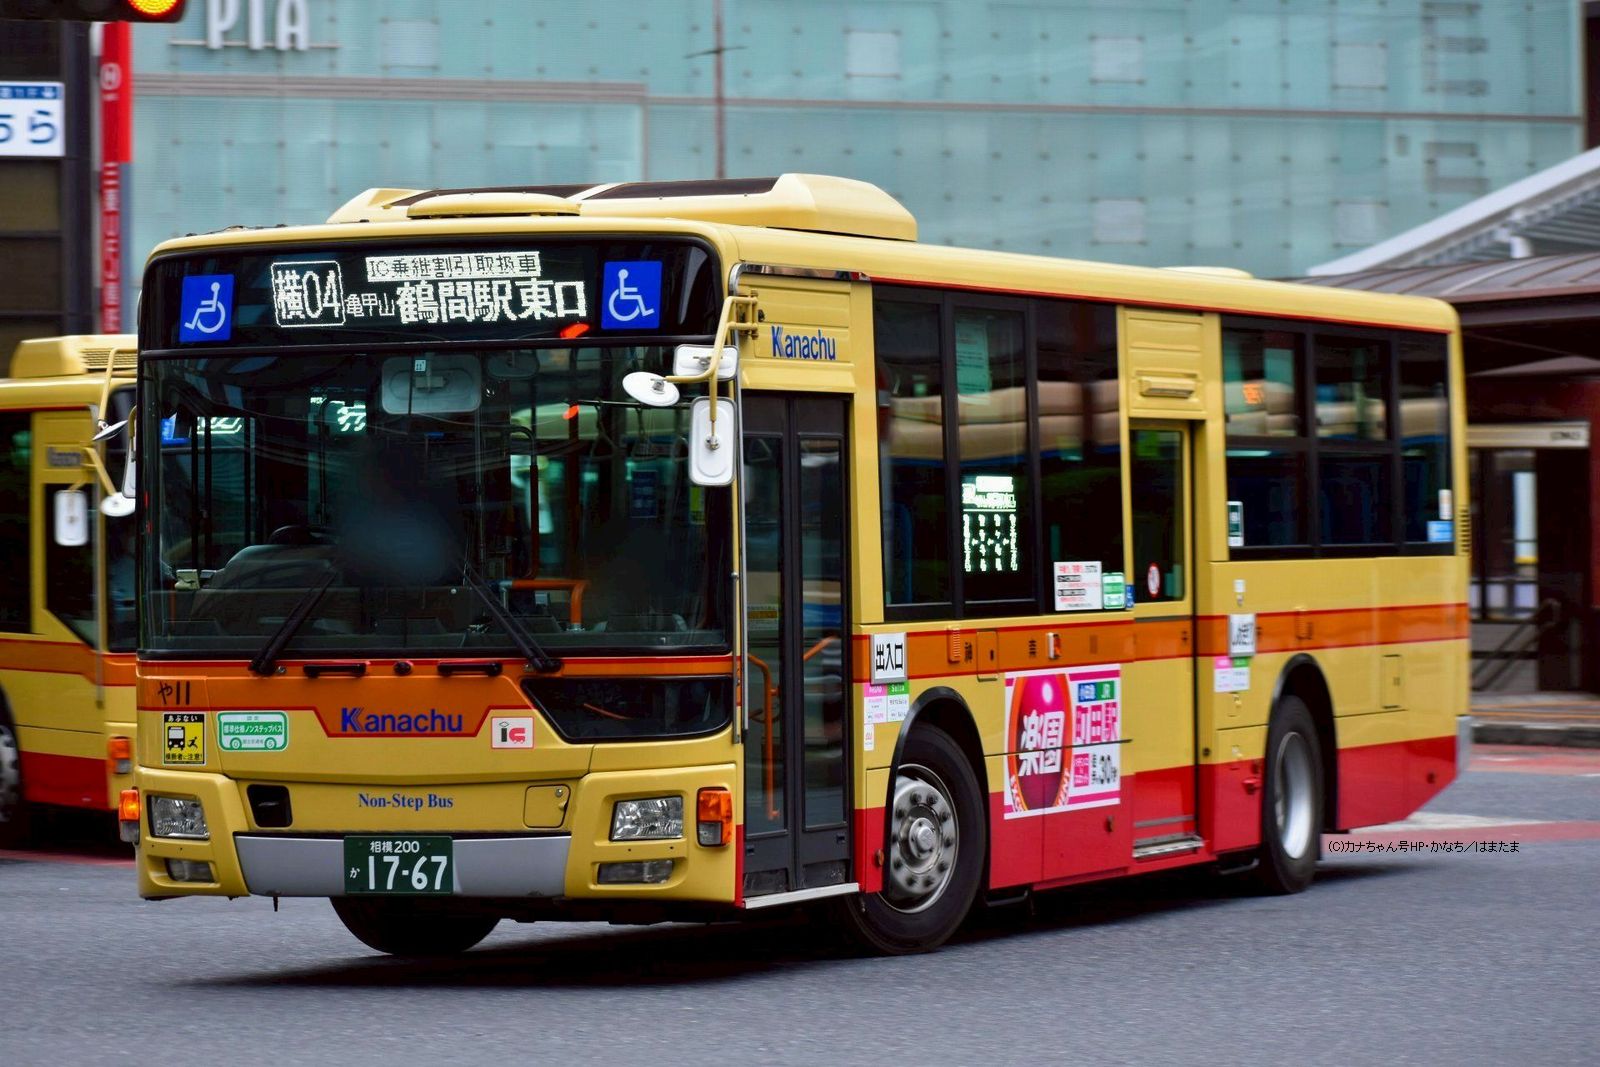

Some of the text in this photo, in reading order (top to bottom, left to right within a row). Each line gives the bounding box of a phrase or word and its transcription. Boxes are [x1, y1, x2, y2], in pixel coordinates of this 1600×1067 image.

[368, 254, 537, 279] IC乗継割引取扱車
[275, 270, 341, 319] 横04
[345, 278, 587, 324] 亀甲山 鶴間駅東口
[771, 325, 836, 360] Kanachu
[876, 643, 904, 672] 出入口
[158, 680, 191, 706] や11
[341, 707, 463, 732] Kanachu
[1017, 709, 1065, 777] 楽園
[358, 793, 454, 811] Non-Step Bus
[350, 855, 448, 890] か 17-67
